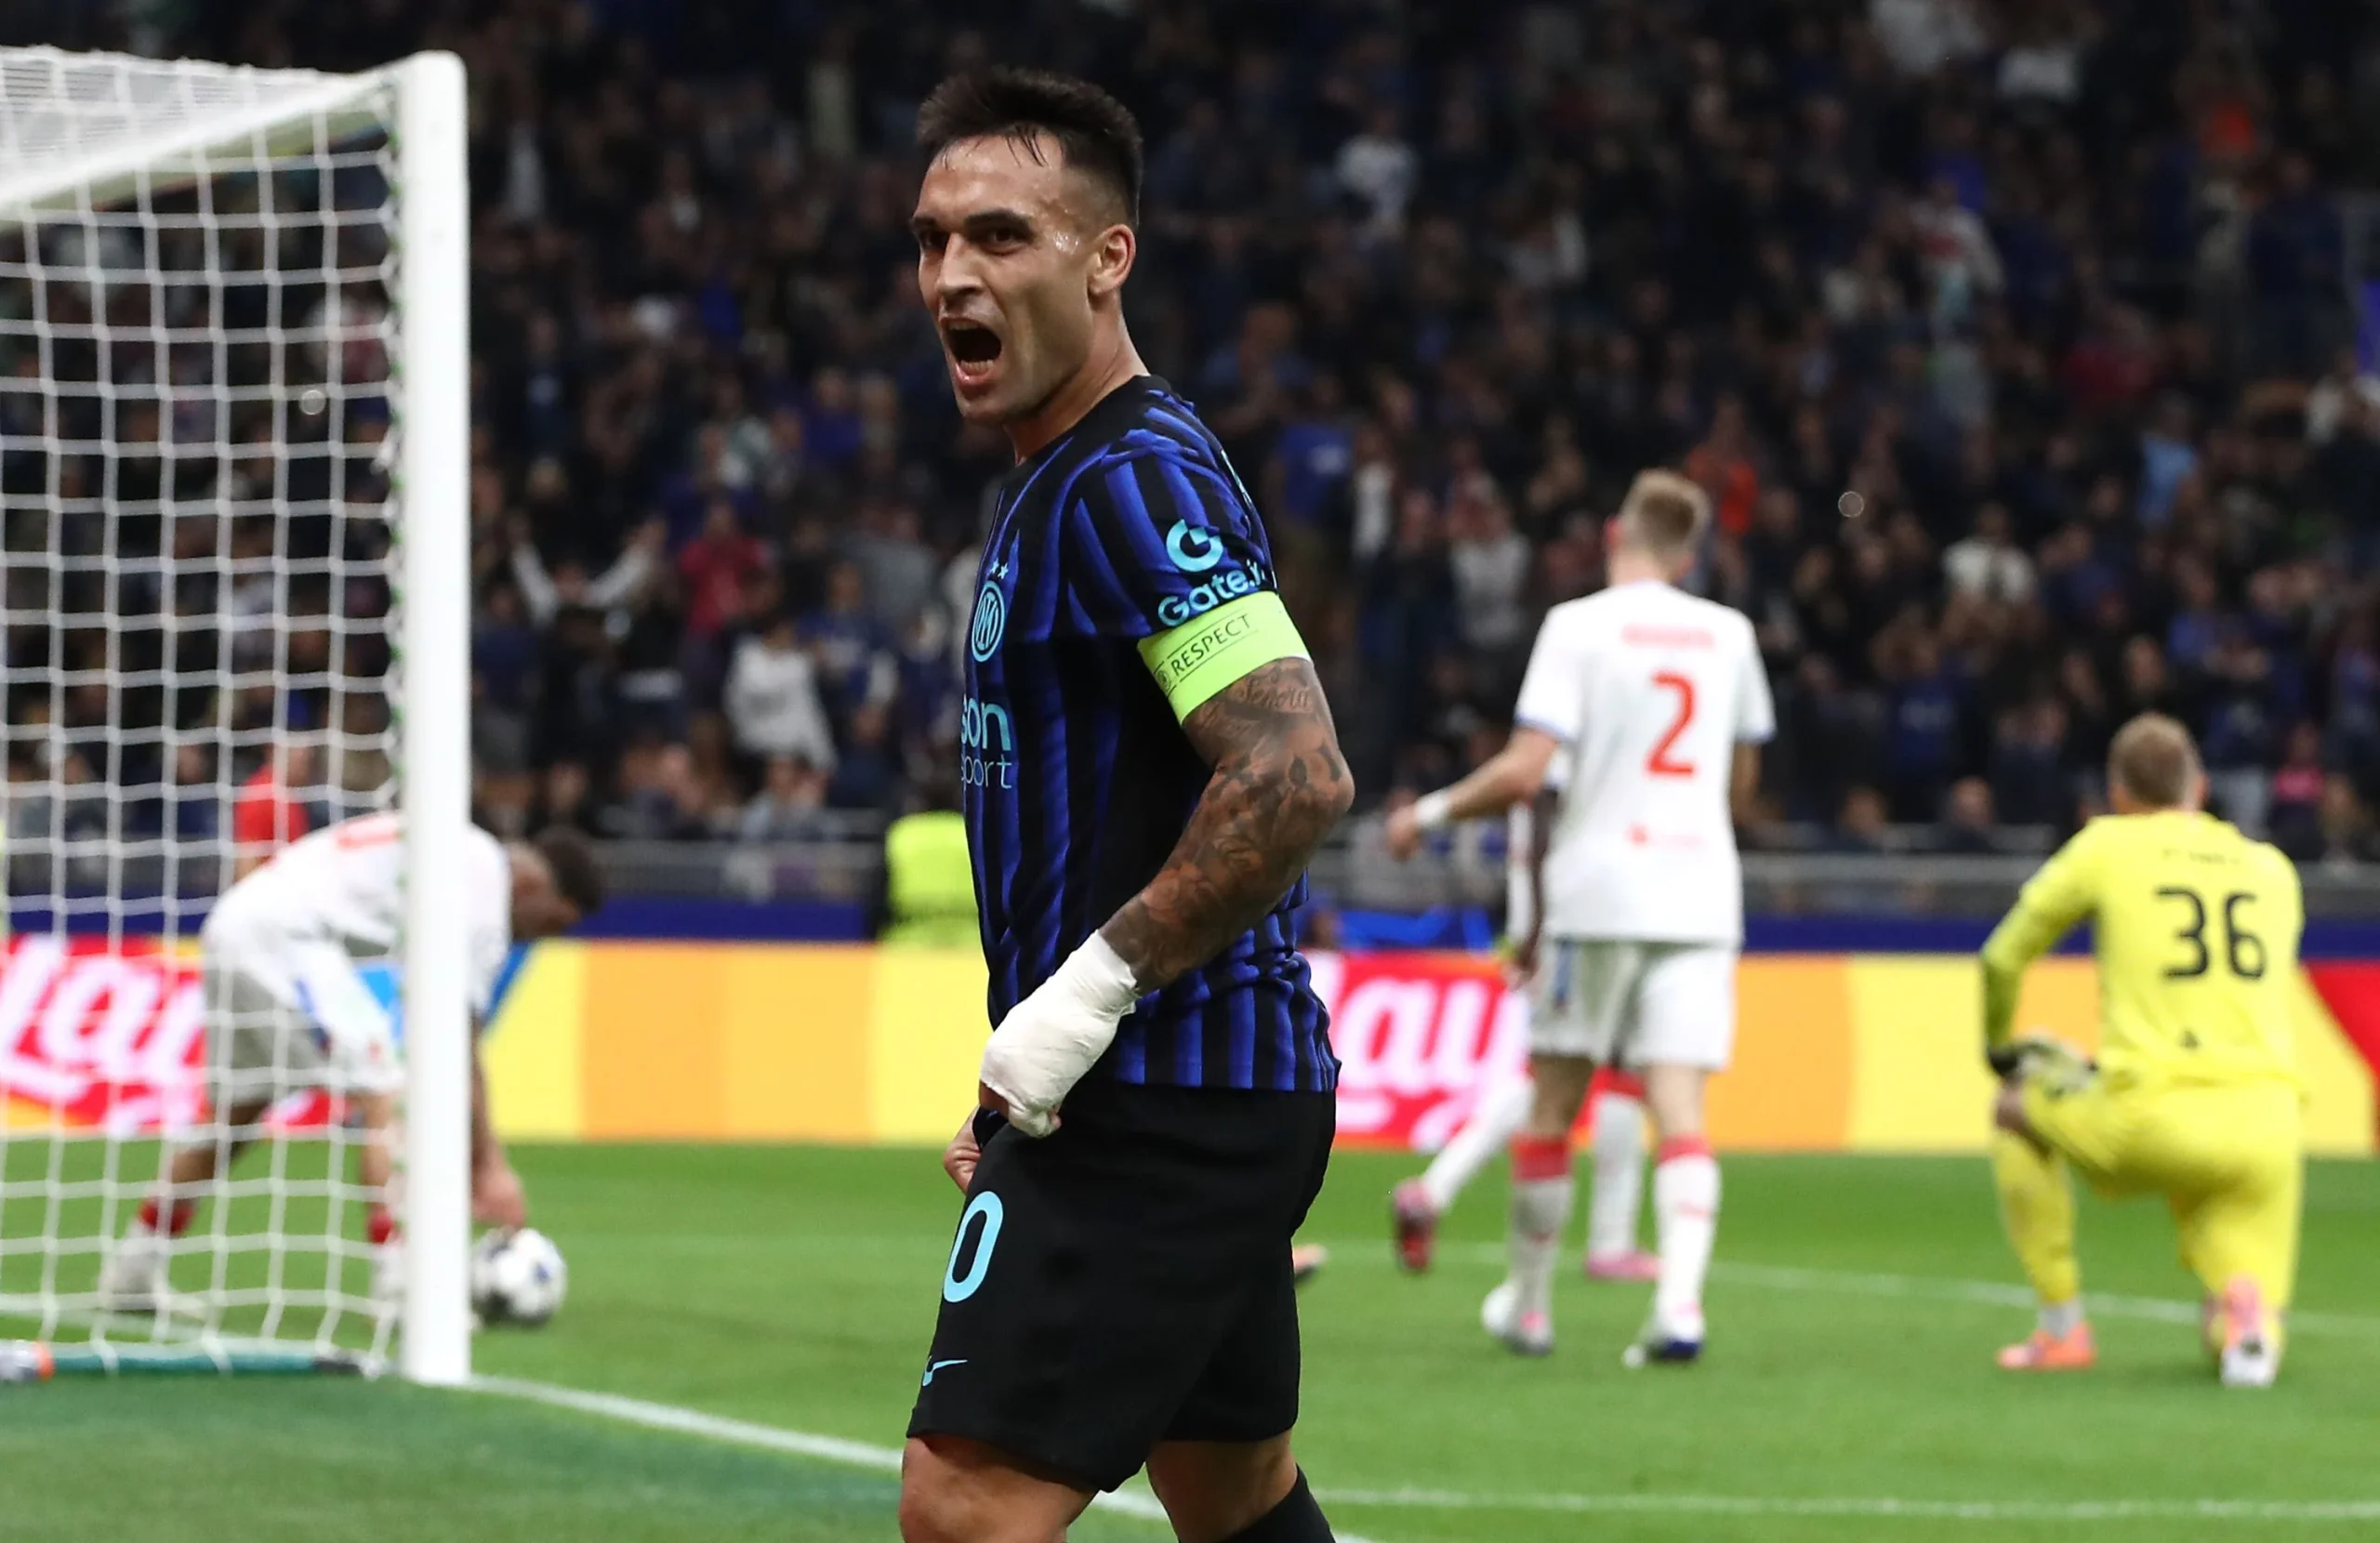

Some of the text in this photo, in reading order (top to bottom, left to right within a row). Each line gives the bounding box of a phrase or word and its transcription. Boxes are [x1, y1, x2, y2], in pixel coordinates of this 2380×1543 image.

[1170, 613, 1251, 677] RESPECT
[1646, 672, 1697, 775] 2
[961, 754, 1012, 791] port
[2155, 887, 2267, 980] 36
[943, 1191, 1004, 1302] 0
